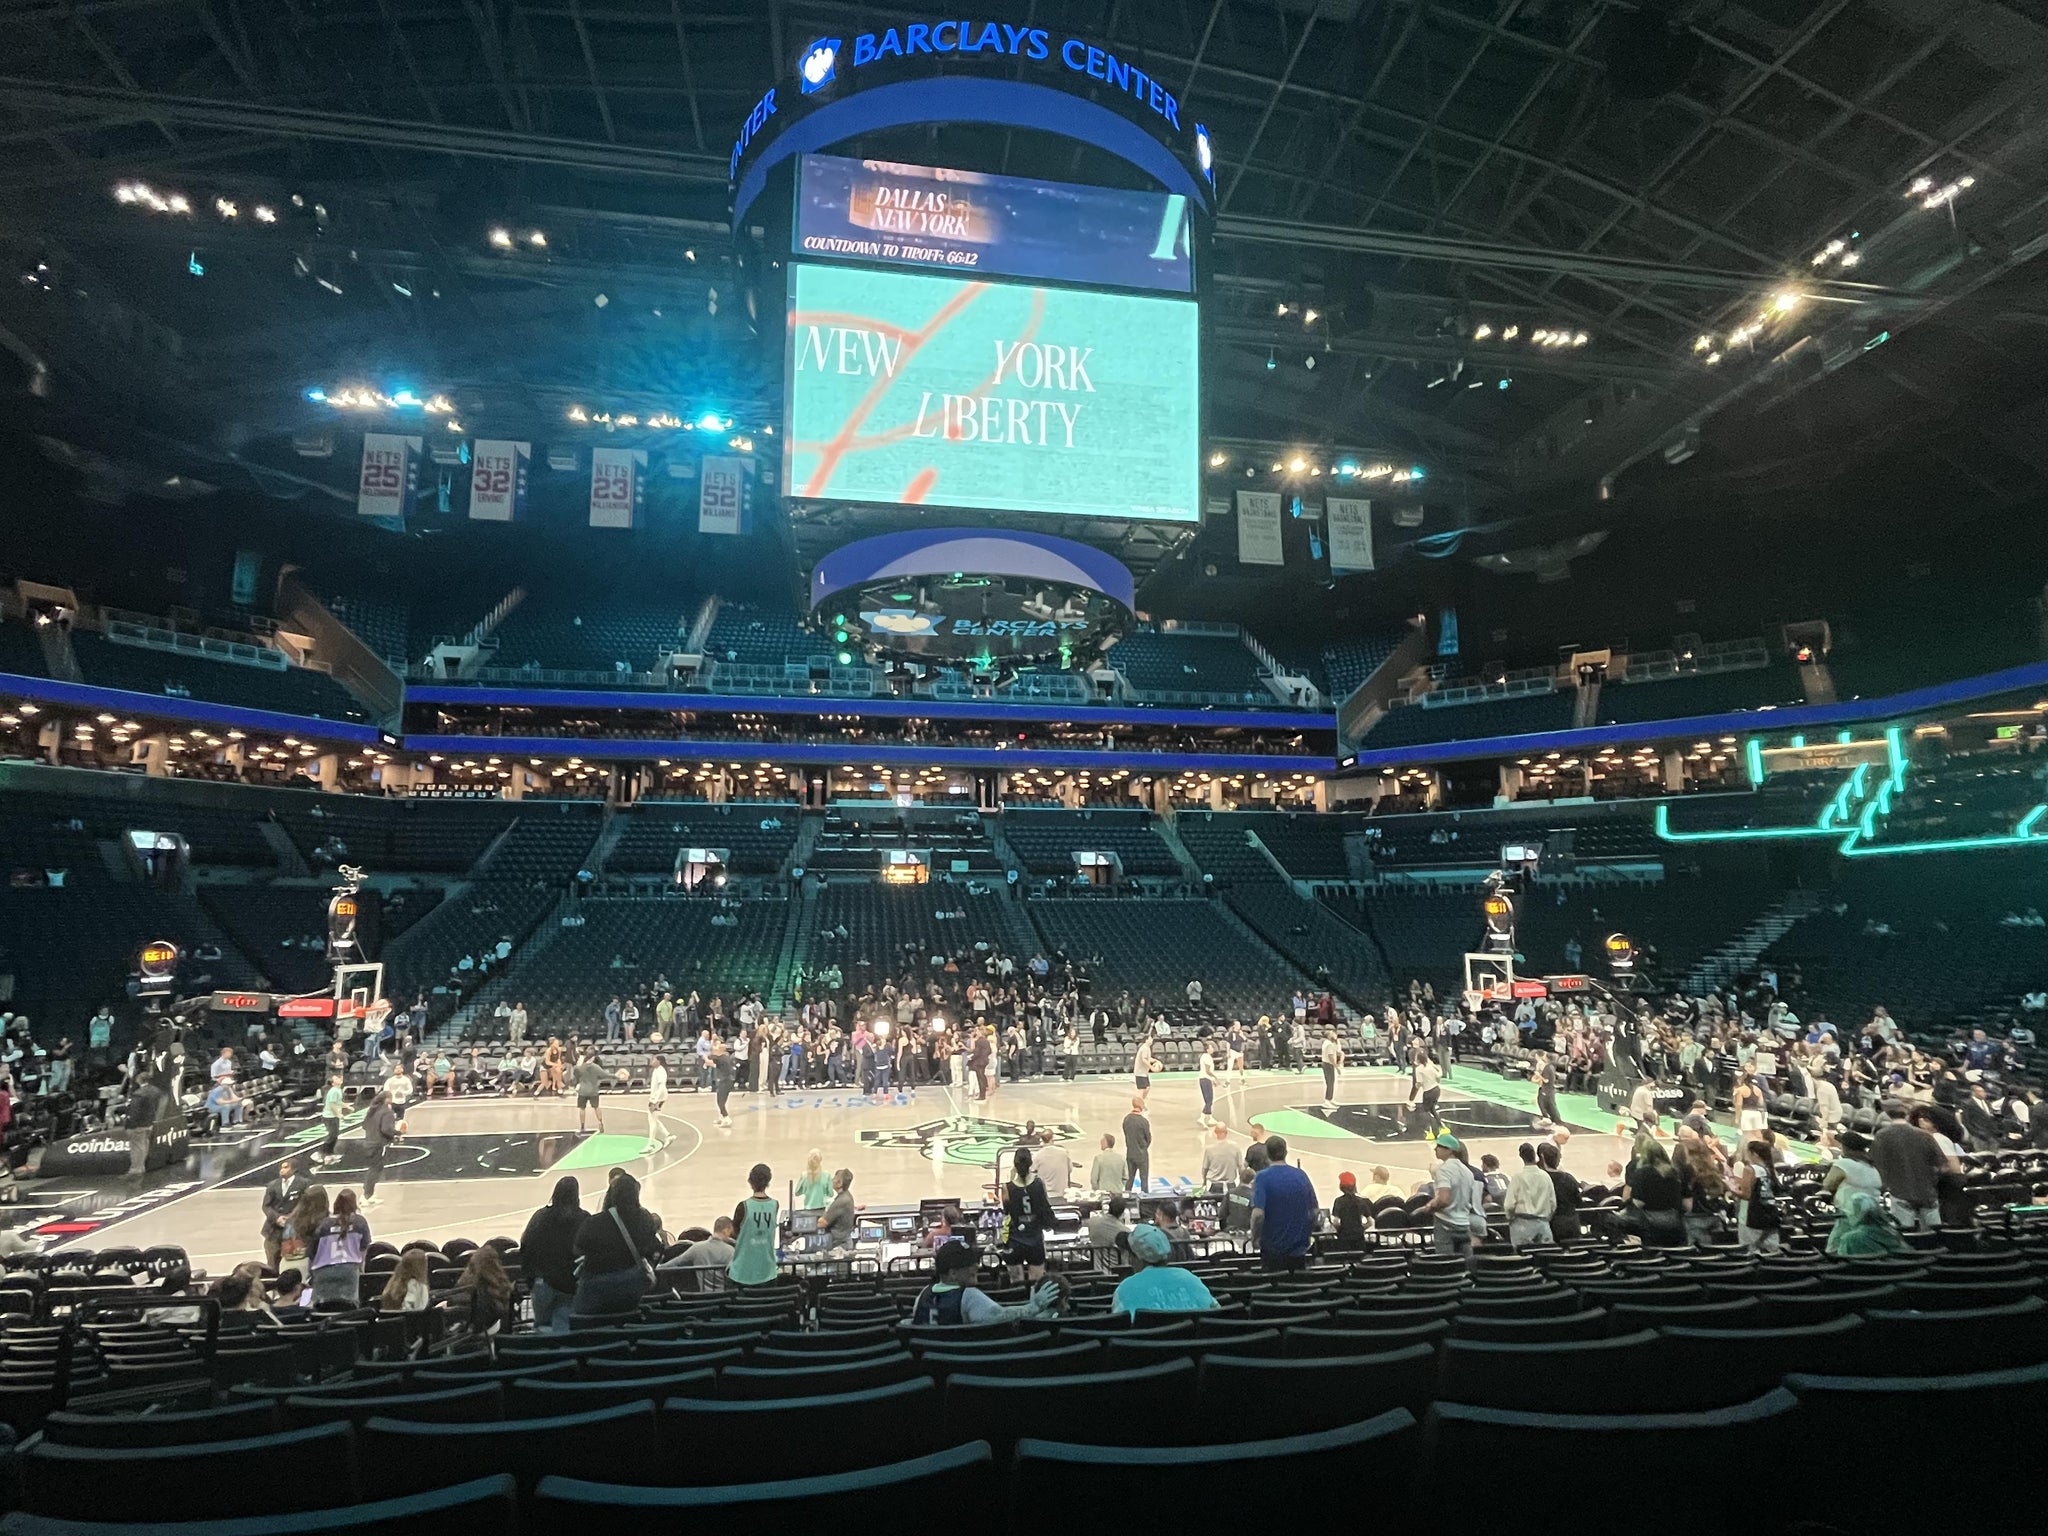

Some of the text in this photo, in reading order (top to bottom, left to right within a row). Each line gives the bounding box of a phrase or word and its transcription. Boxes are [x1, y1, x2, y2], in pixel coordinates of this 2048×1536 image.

[854, 21, 1181, 131] BARCLAYS CENTER
[875, 187, 947, 211] DALLAS
[871, 206, 968, 237] NEW YORK
[804, 236, 881, 257] COUNTDOWN
[882, 244, 898, 258] TO
[798, 325, 1095, 392] NEW YORK
[912, 391, 1083, 448] LIBERTY
[366, 451, 402, 464] NETS
[476, 456, 510, 470] NETS
[364, 464, 400, 487] 25
[474, 469, 510, 492] 32
[595, 463, 629, 477] NETS
[704, 471, 736, 485] NETS
[594, 477, 628, 500] 23
[703, 484, 736, 507] 52
[951, 628, 1056, 637] CENTER
[67, 1137, 132, 1154] coinbas
[1022, 1195, 1032, 1214] 5
